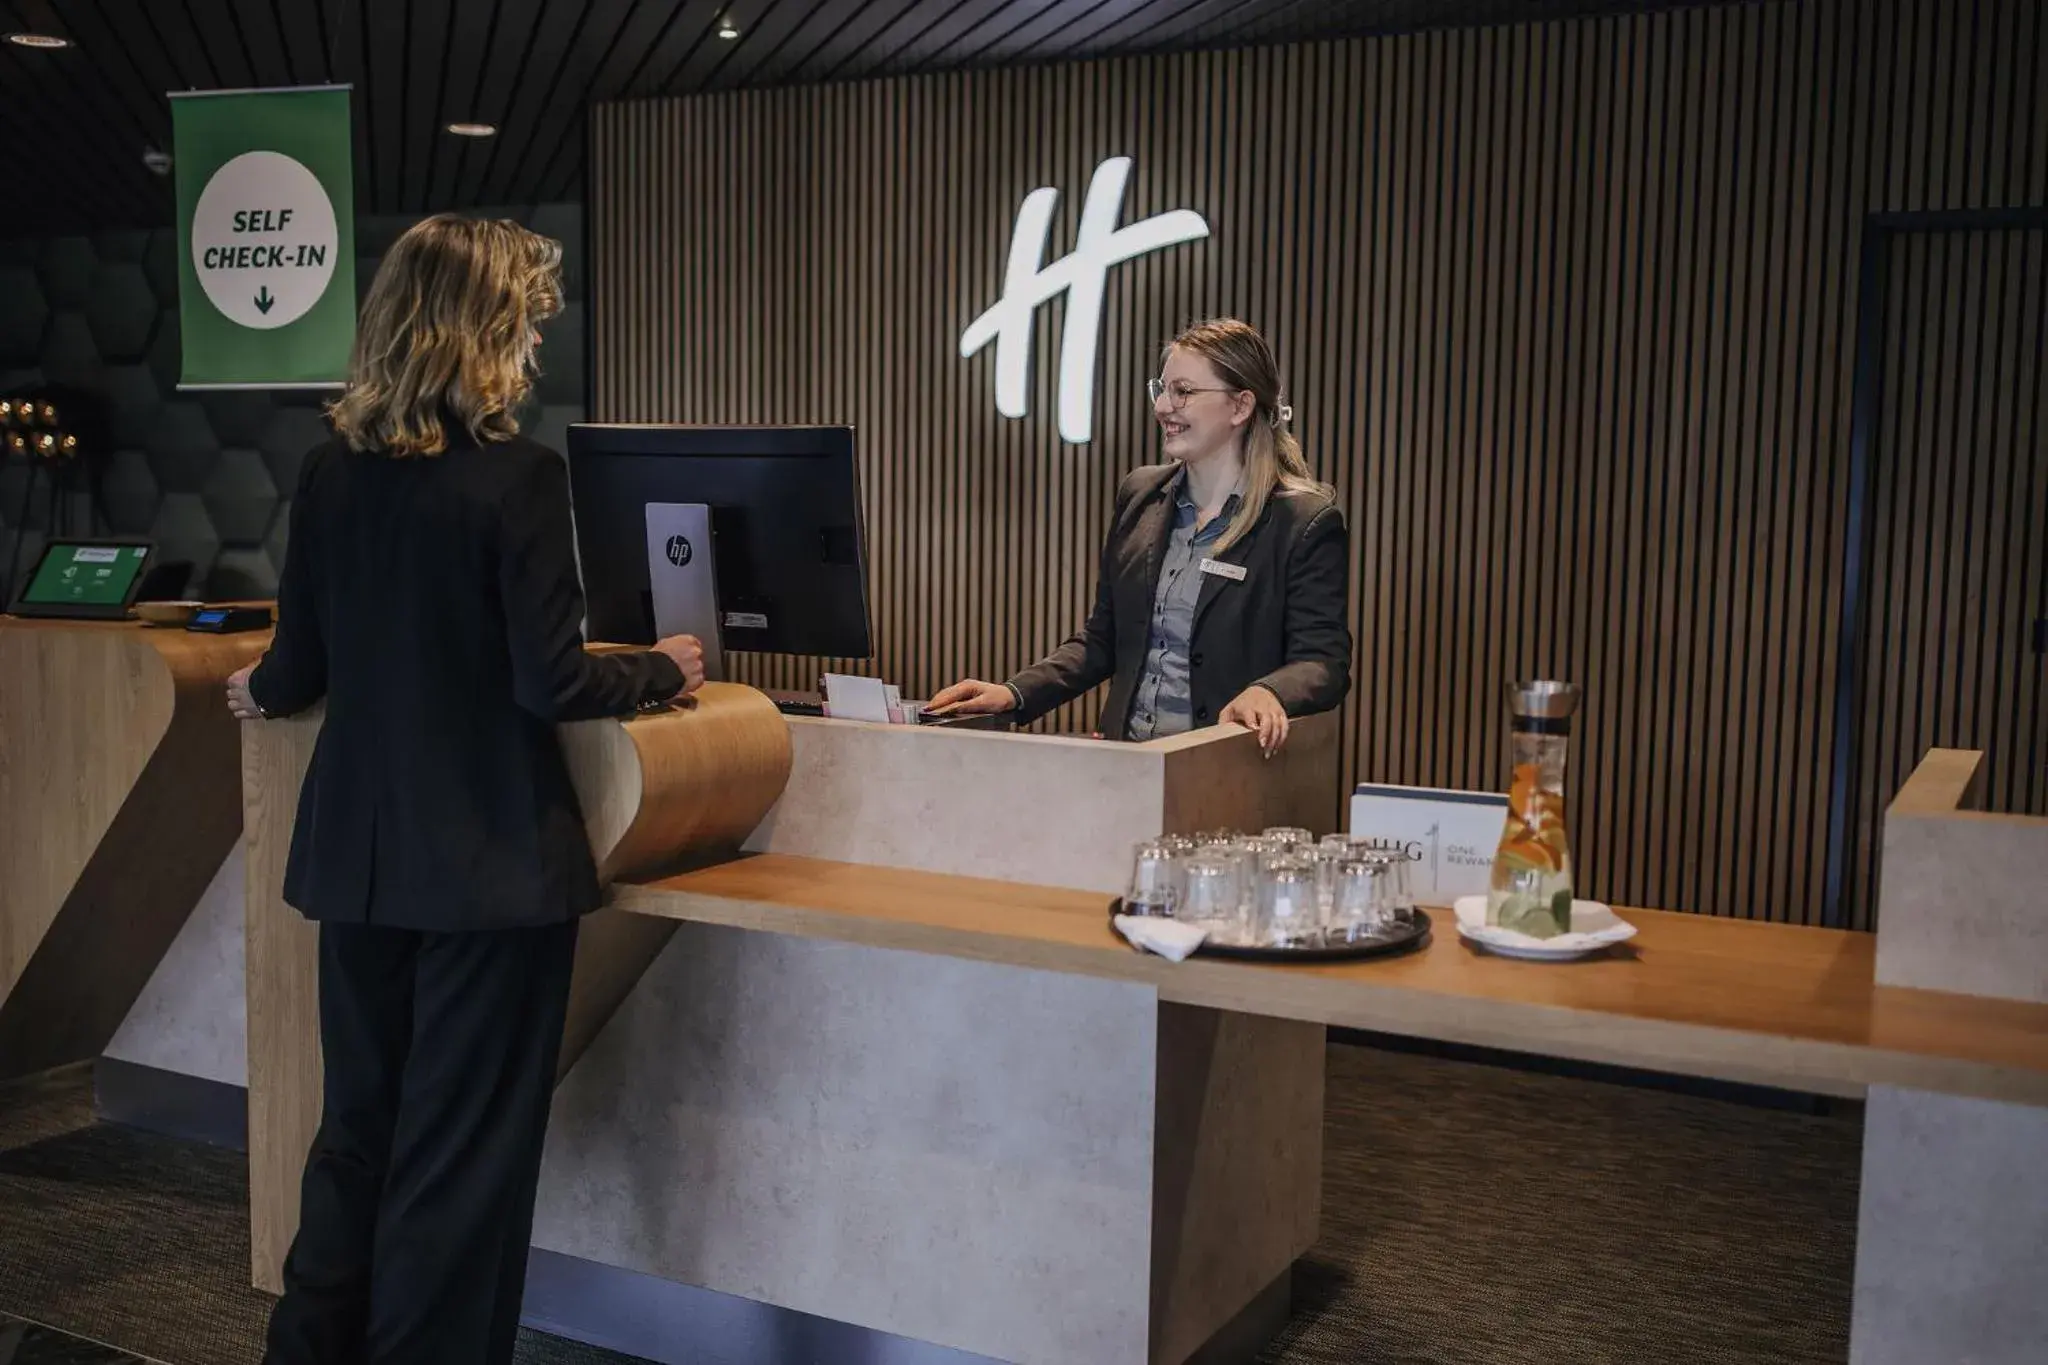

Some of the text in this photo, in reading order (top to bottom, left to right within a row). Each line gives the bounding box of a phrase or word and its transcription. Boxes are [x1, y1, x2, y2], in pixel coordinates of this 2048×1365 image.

[232, 209, 293, 232] SELF
[203, 244, 326, 269] CHECK-IN
[960, 156, 1210, 443] H
[668, 535, 690, 567] hp
[1447, 844, 1476, 855] ONE
